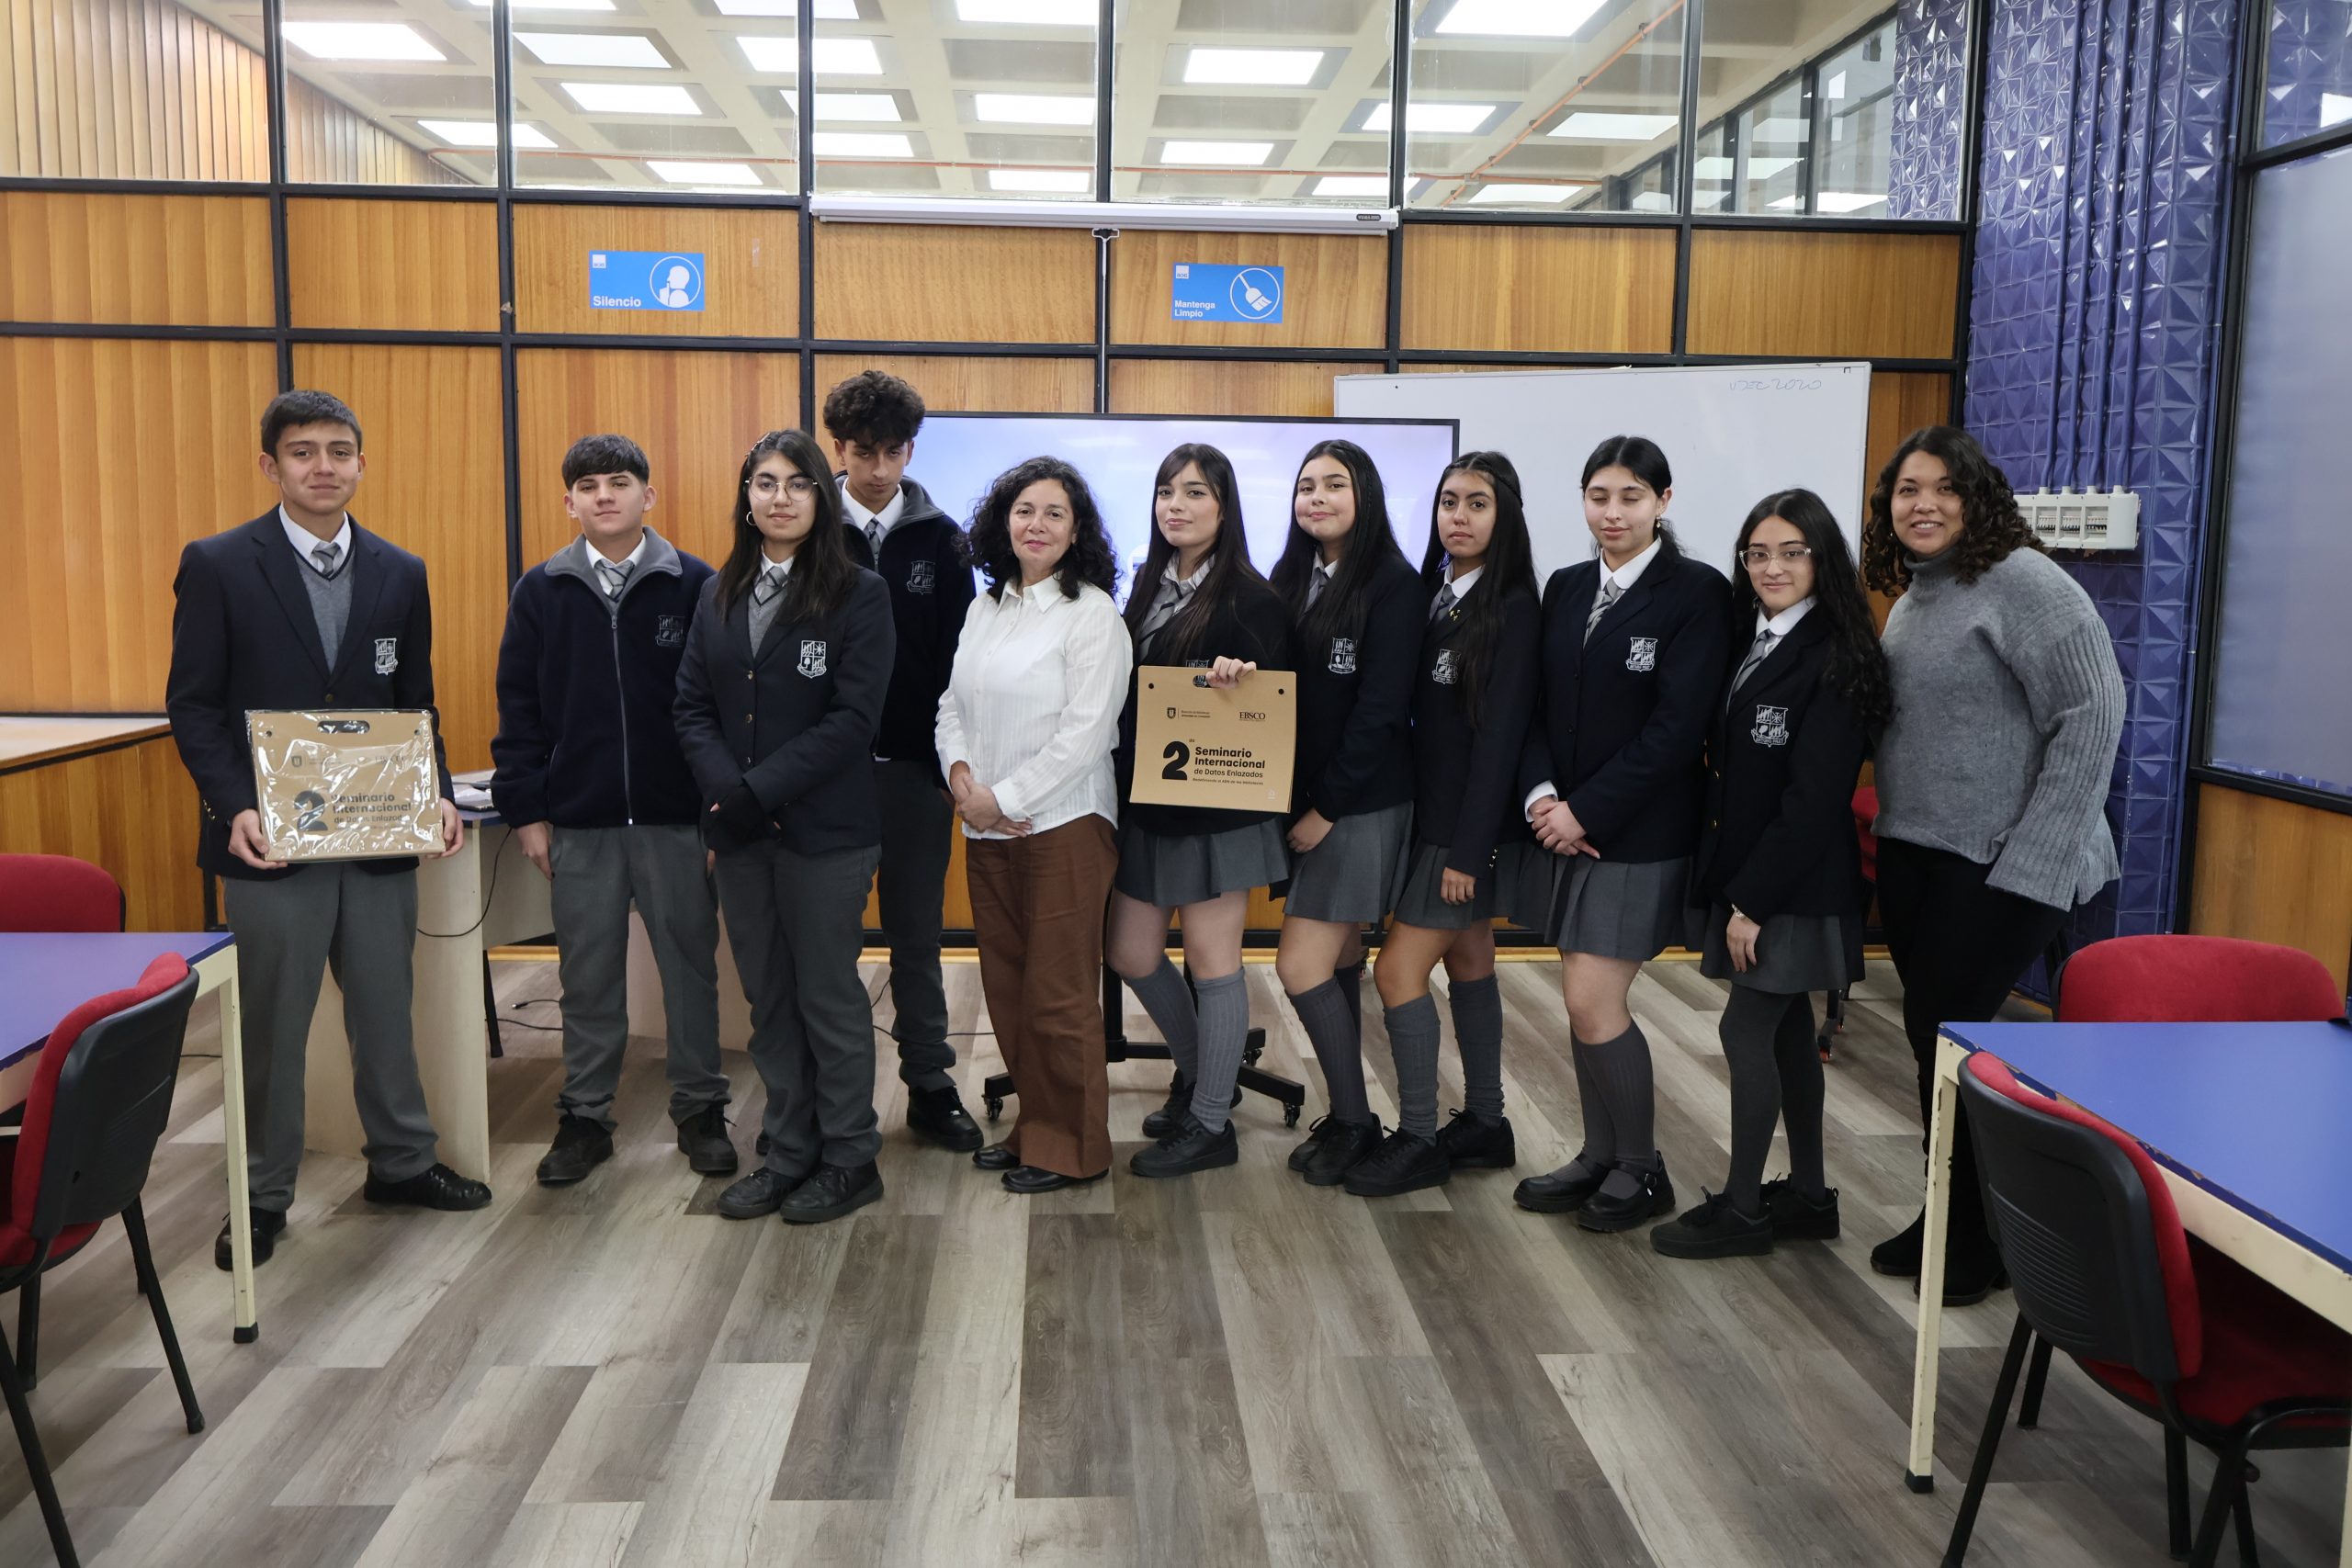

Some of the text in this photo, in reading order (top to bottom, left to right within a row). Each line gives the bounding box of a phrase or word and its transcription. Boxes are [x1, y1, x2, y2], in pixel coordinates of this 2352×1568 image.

[593, 295, 641, 308] Silencio
[1175, 300, 1216, 310] Mantenga
[1175, 310, 1204, 318] Limpio
[1194, 746, 1252, 758] Seminario
[1162, 741, 1190, 780] 2
[1194, 757, 1265, 769] Internacional
[1227, 770, 1263, 778] Enlazados
[294, 791, 328, 830] 2
